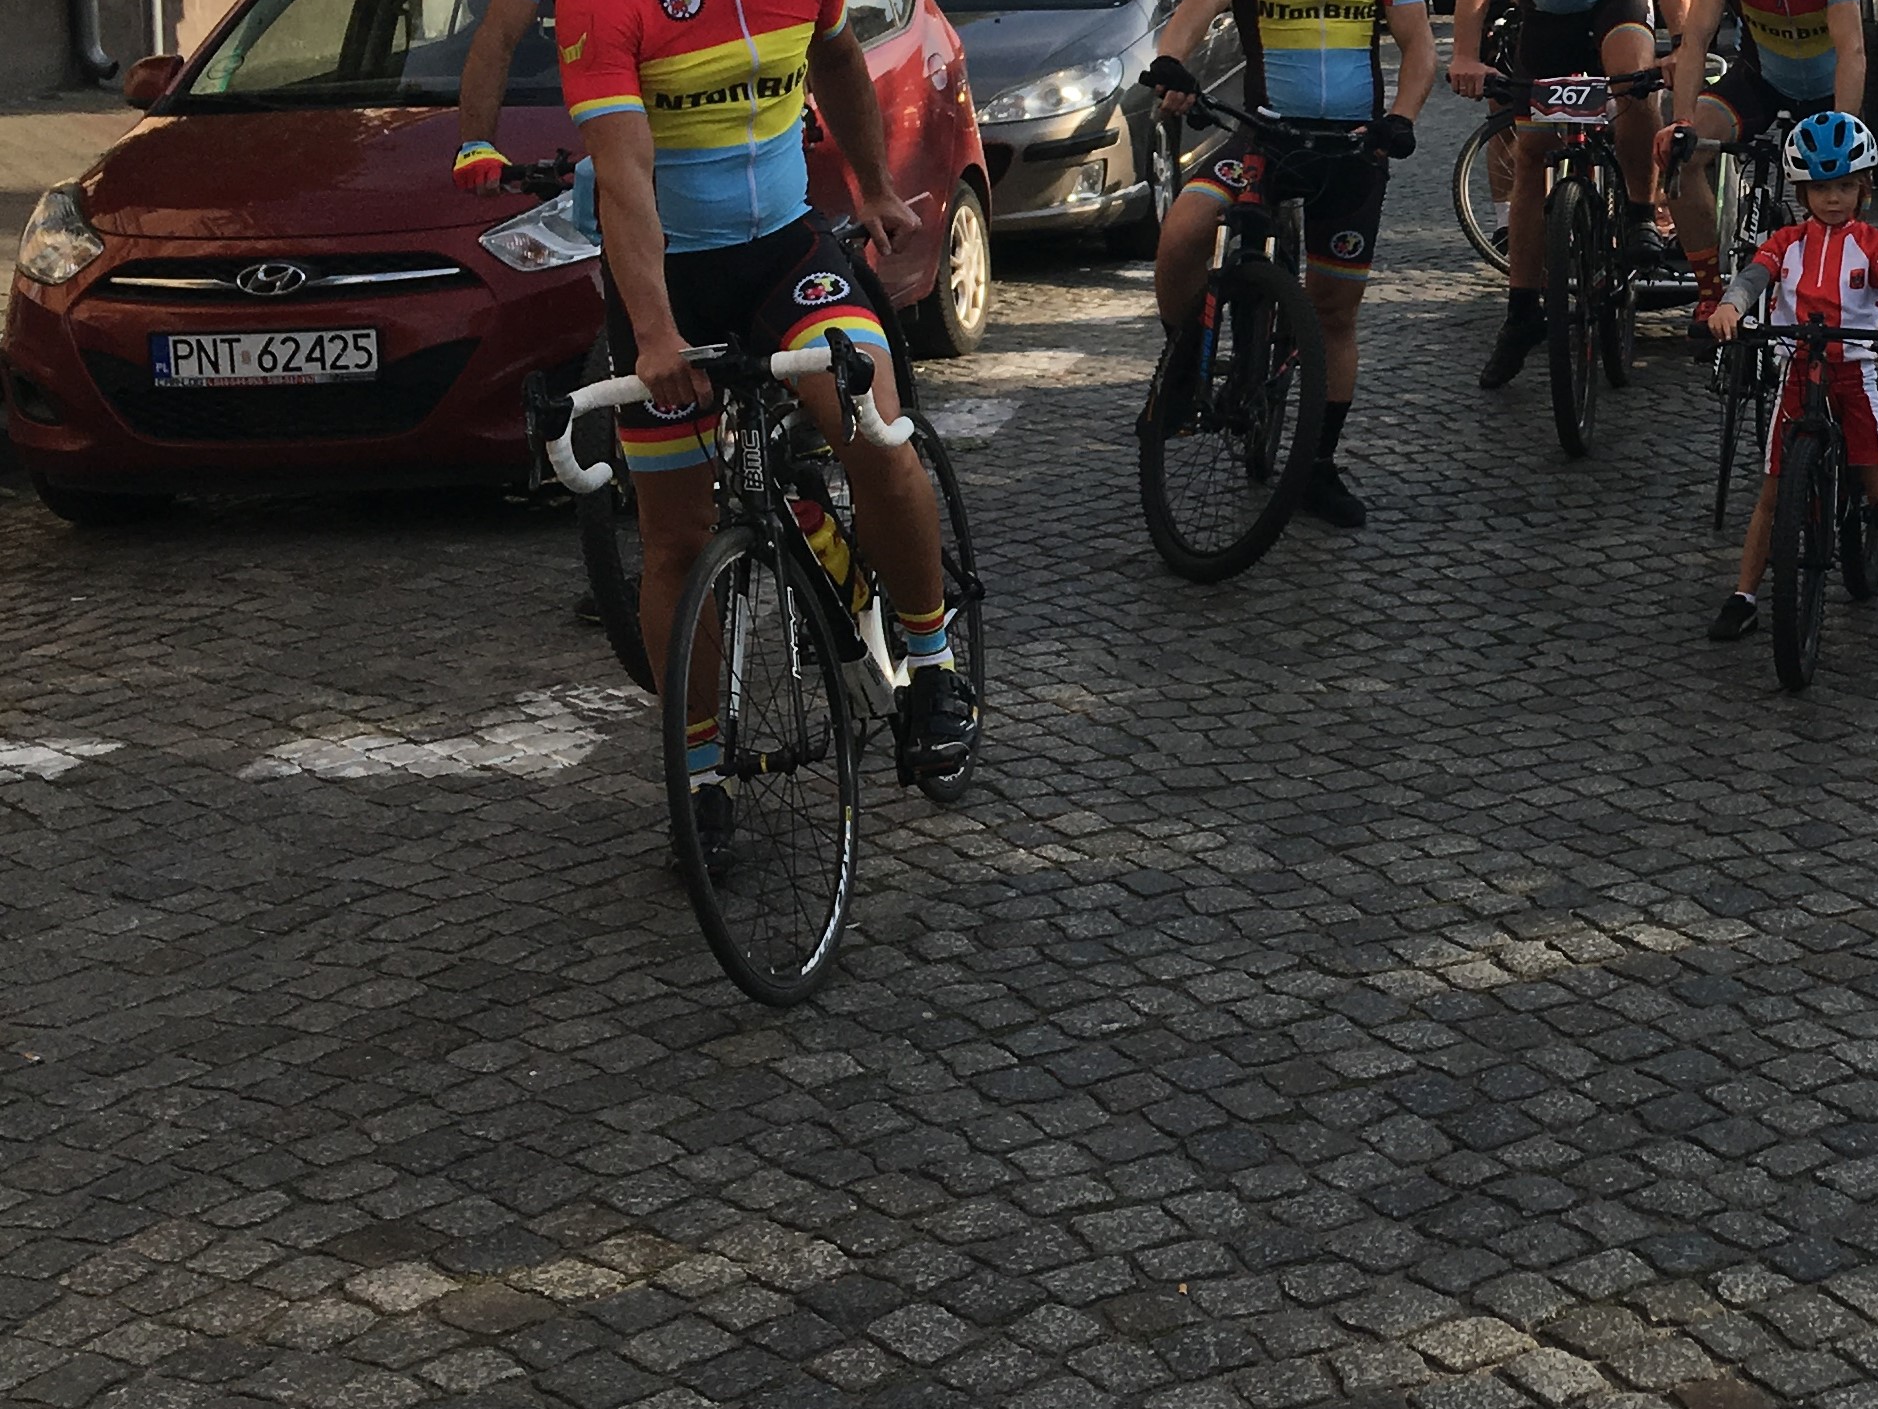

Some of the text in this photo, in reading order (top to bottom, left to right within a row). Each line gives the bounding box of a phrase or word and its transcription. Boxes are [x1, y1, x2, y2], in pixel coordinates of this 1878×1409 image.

[1547, 85, 1591, 105] 267
[172, 333, 373, 376] PNT 62425
[742, 429, 766, 492] BMC
